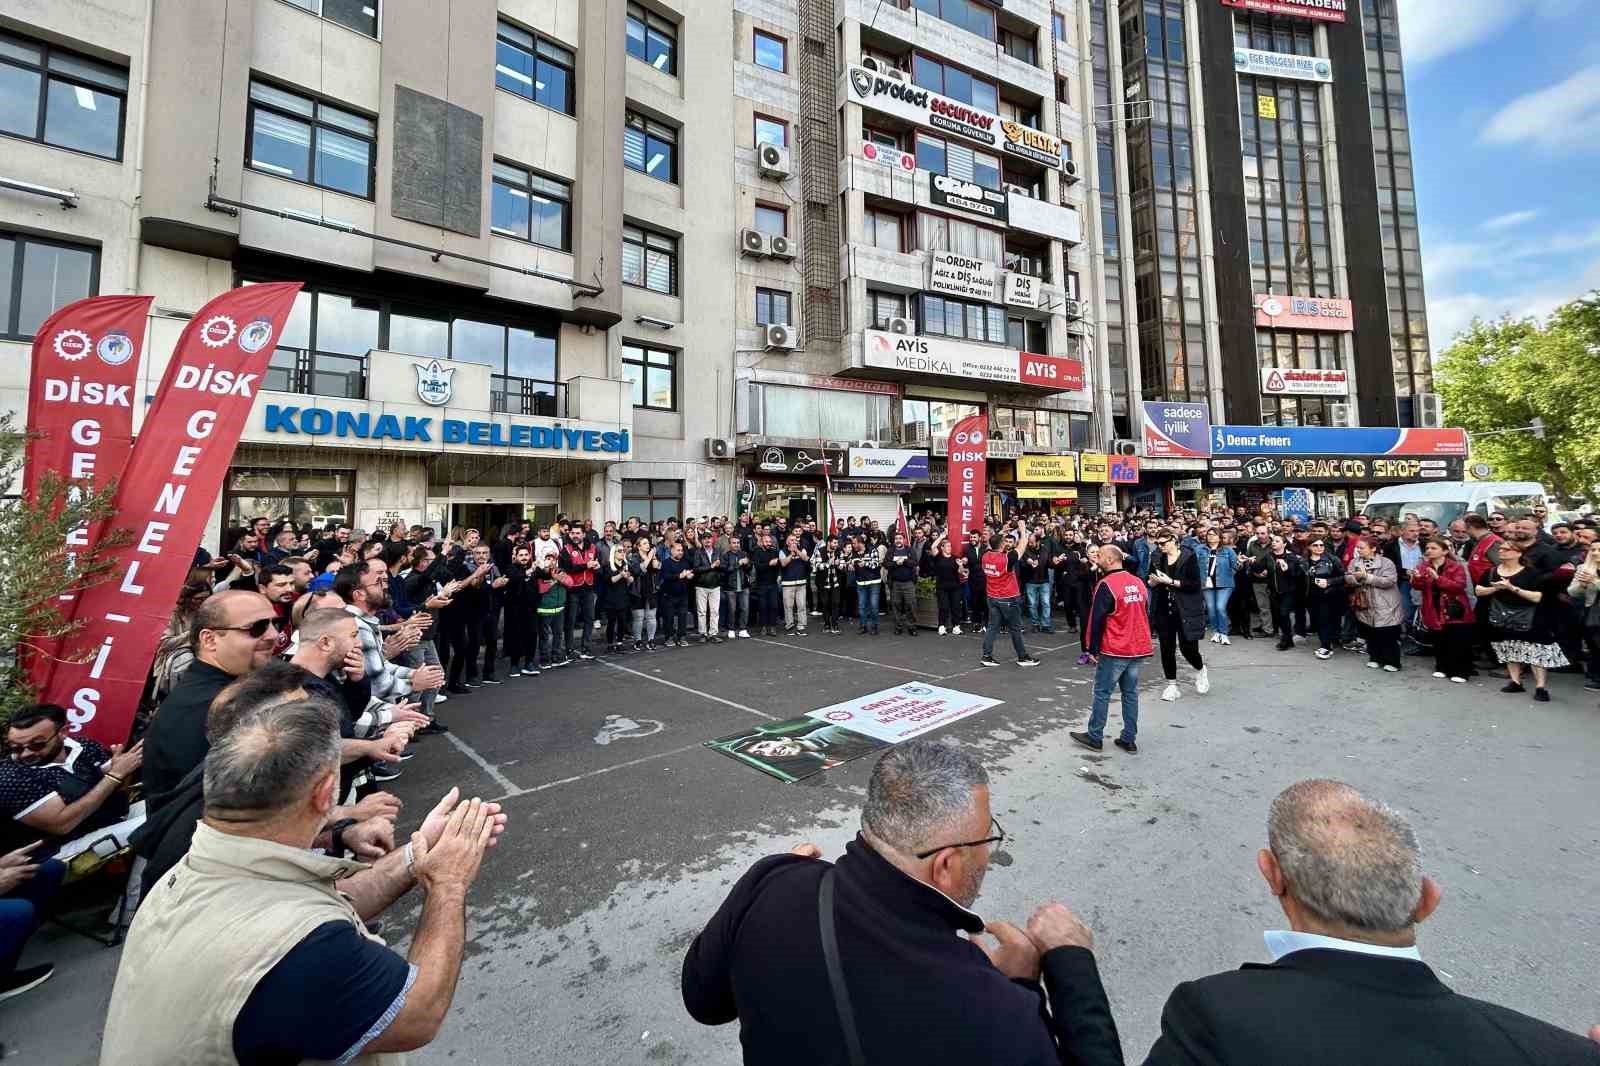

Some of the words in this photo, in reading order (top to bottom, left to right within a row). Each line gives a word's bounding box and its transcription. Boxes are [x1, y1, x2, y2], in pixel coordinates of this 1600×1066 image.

[873, 77, 928, 109] protect
[933, 116, 961, 132] KORUMA
[946, 255, 984, 271] ORDENT
[935, 268, 949, 278] AĞIZ
[957, 270, 971, 285] DİŞ
[1016, 277, 1031, 292] DİŞ
[896, 338, 928, 354] AYİS
[896, 356, 956, 374] MEDİKAL
[1025, 362, 1057, 378] AYİS
[175, 363, 259, 397] DİSK
[45, 376, 131, 406] DİSK
[1163, 406, 1203, 418] sadece
[264, 404, 433, 442] KONAK
[442, 418, 630, 453] BELEDİYESİ
[1164, 421, 1189, 436] iyilik
[865, 458, 896, 467] TURKCELL
[952, 451, 983, 462] DİSK
[1110, 463, 1136, 481] Ria
[1247, 459, 1276, 478] EGE
[1281, 459, 1366, 478] TOBACCO
[1373, 459, 1420, 477] SHOP
